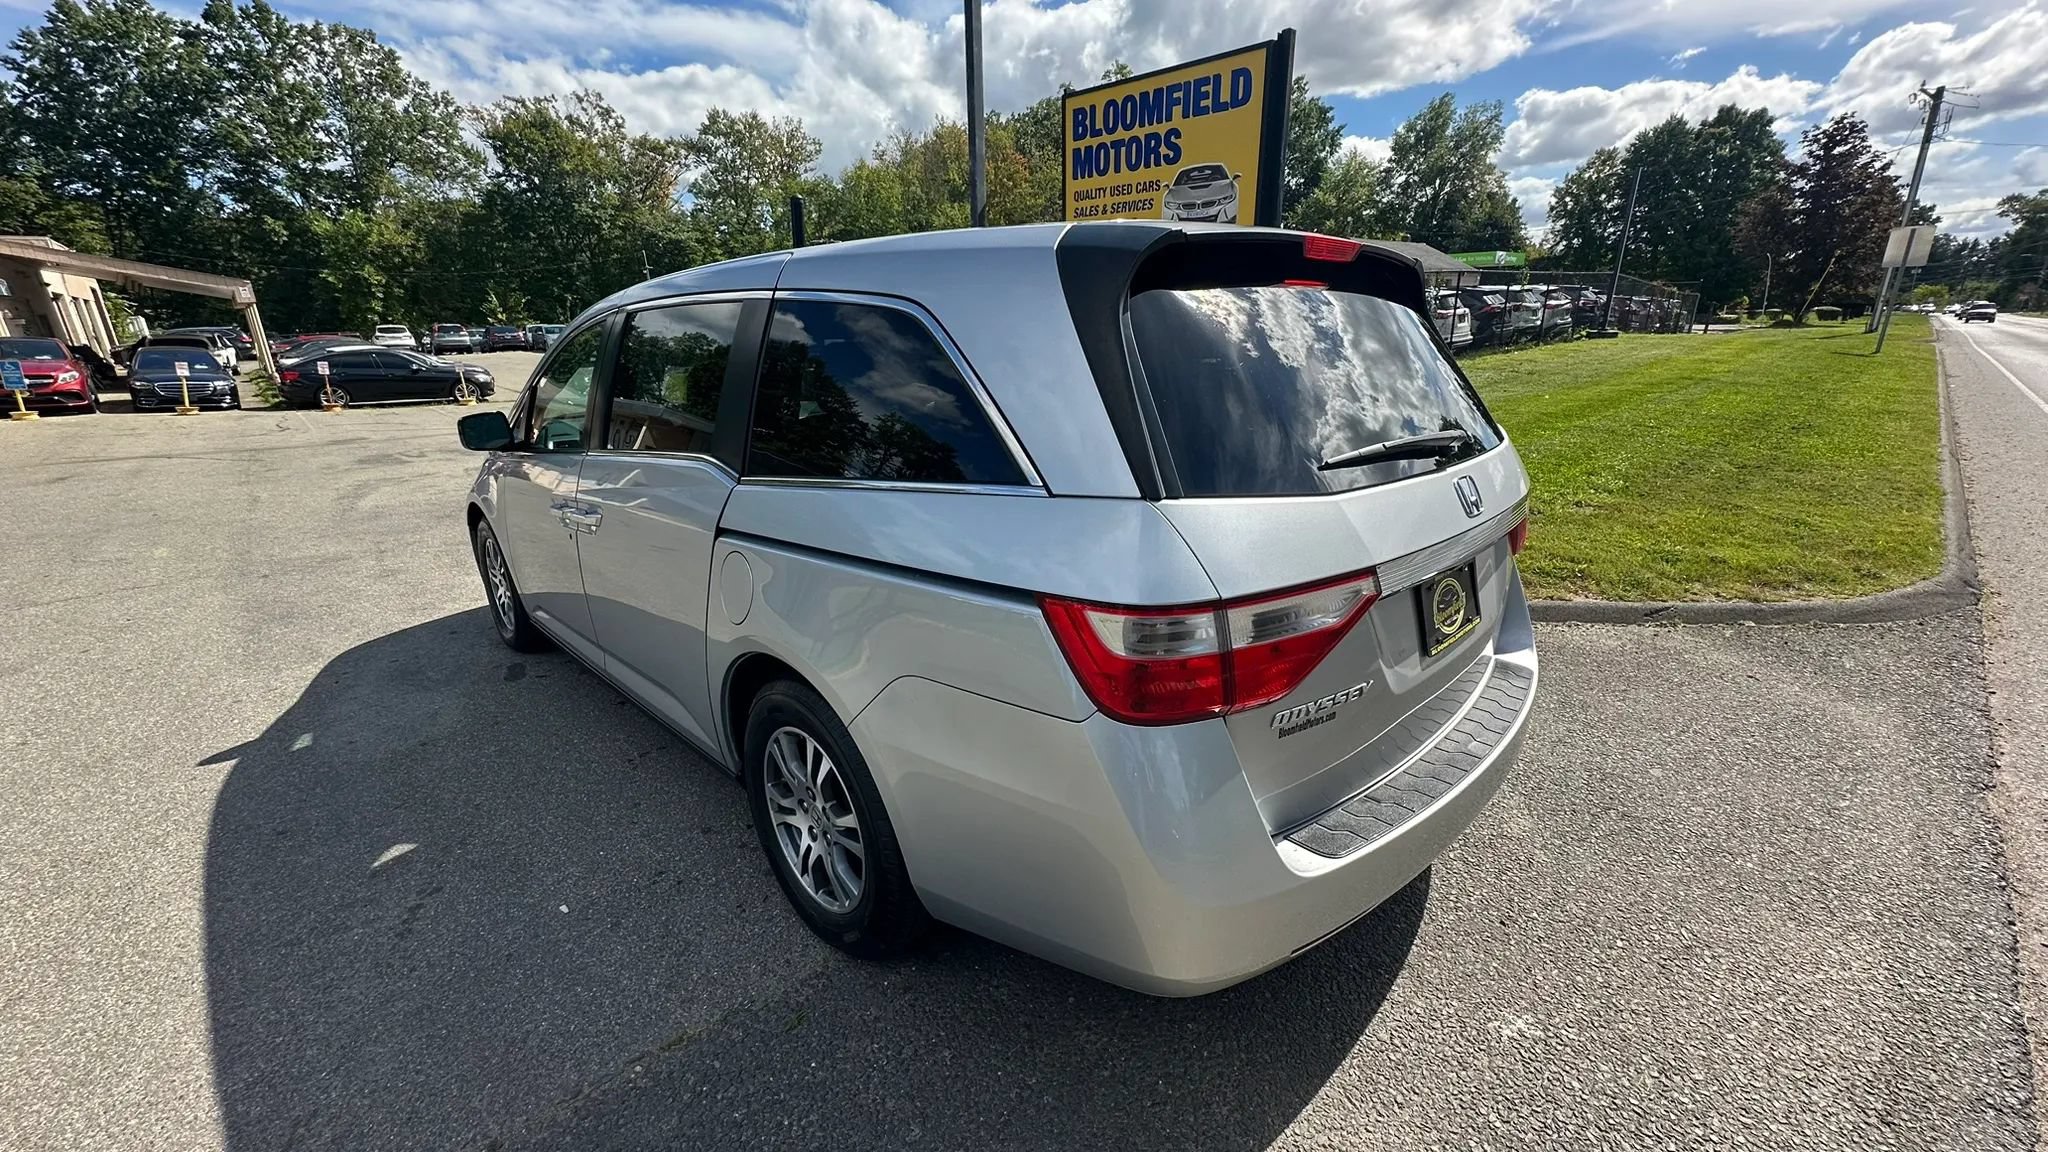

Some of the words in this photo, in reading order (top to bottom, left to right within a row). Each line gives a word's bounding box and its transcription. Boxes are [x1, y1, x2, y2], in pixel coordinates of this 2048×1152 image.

[1073, 67, 1252, 141] BLOOMFIELD
[1072, 127, 1182, 180] MOTORS
[1073, 187, 1107, 202] QUALITY
[1109, 183, 1132, 197] USED
[1135, 179, 1161, 194] CARS
[1073, 206, 1099, 219] SALES
[1101, 203, 1108, 216] &
[1109, 198, 1154, 214] SERVICES
[1270, 680, 1374, 729] ODYSSEY
